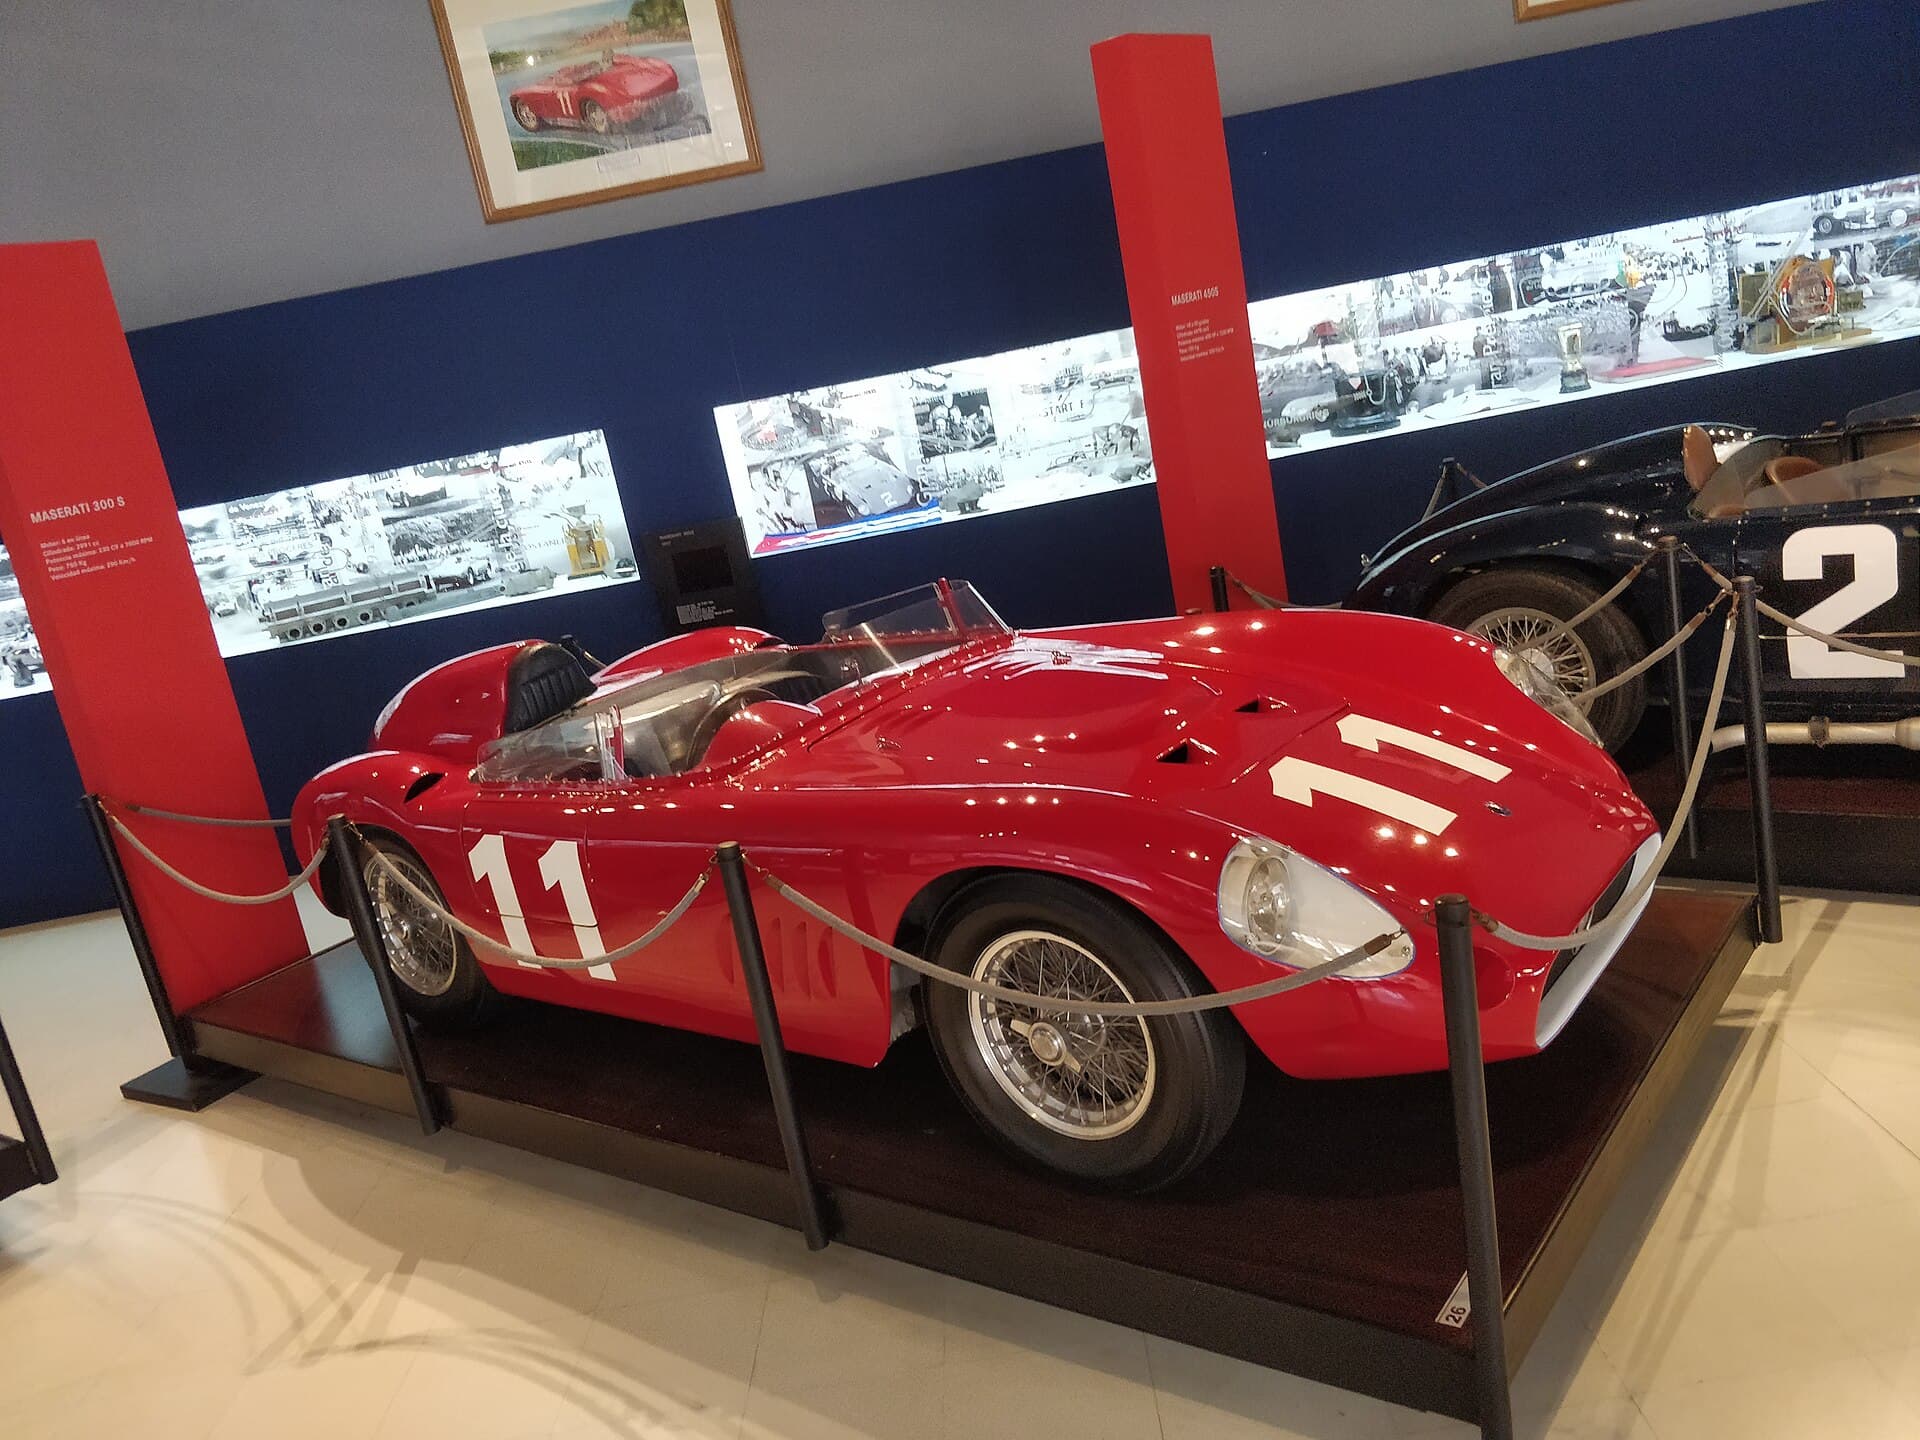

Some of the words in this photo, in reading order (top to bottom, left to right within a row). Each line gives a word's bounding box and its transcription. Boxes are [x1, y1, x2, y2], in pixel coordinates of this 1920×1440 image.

[1171, 289, 1203, 306] MASERATI
[30, 502, 91, 524] MASERATI
[93, 499, 115, 512] 300
[117, 496, 126, 507] S
[1781, 523, 1906, 679] 2
[1268, 713, 1512, 837] 11
[467, 834, 617, 982] 11
[1445, 1305, 1467, 1324] 26
